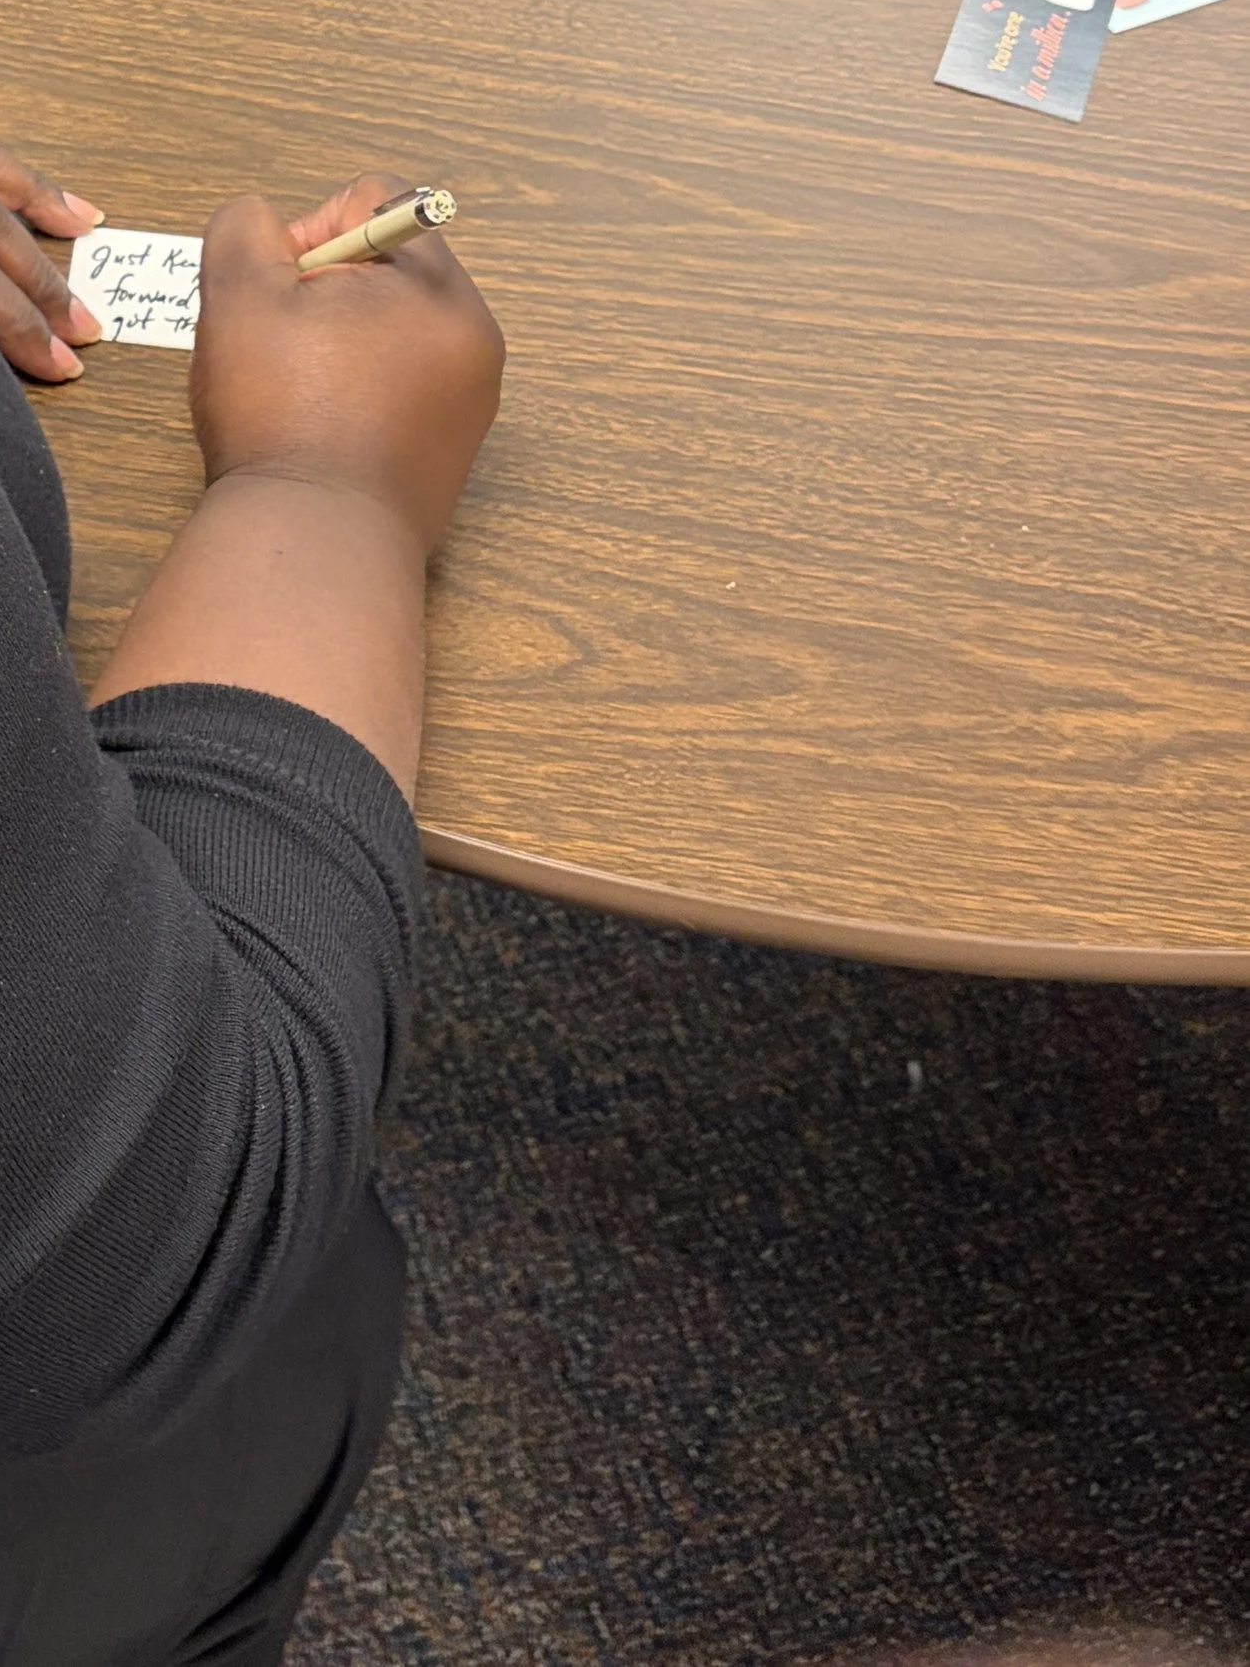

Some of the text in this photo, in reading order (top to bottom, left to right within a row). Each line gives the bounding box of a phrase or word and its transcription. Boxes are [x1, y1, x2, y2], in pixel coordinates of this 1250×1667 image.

[987, 10, 1025, 72] You're one
[1019, 79, 1048, 103] in
[1031, 65, 1052, 82] a
[89, 243, 152, 280] Just
[102, 272, 201, 311] forward
